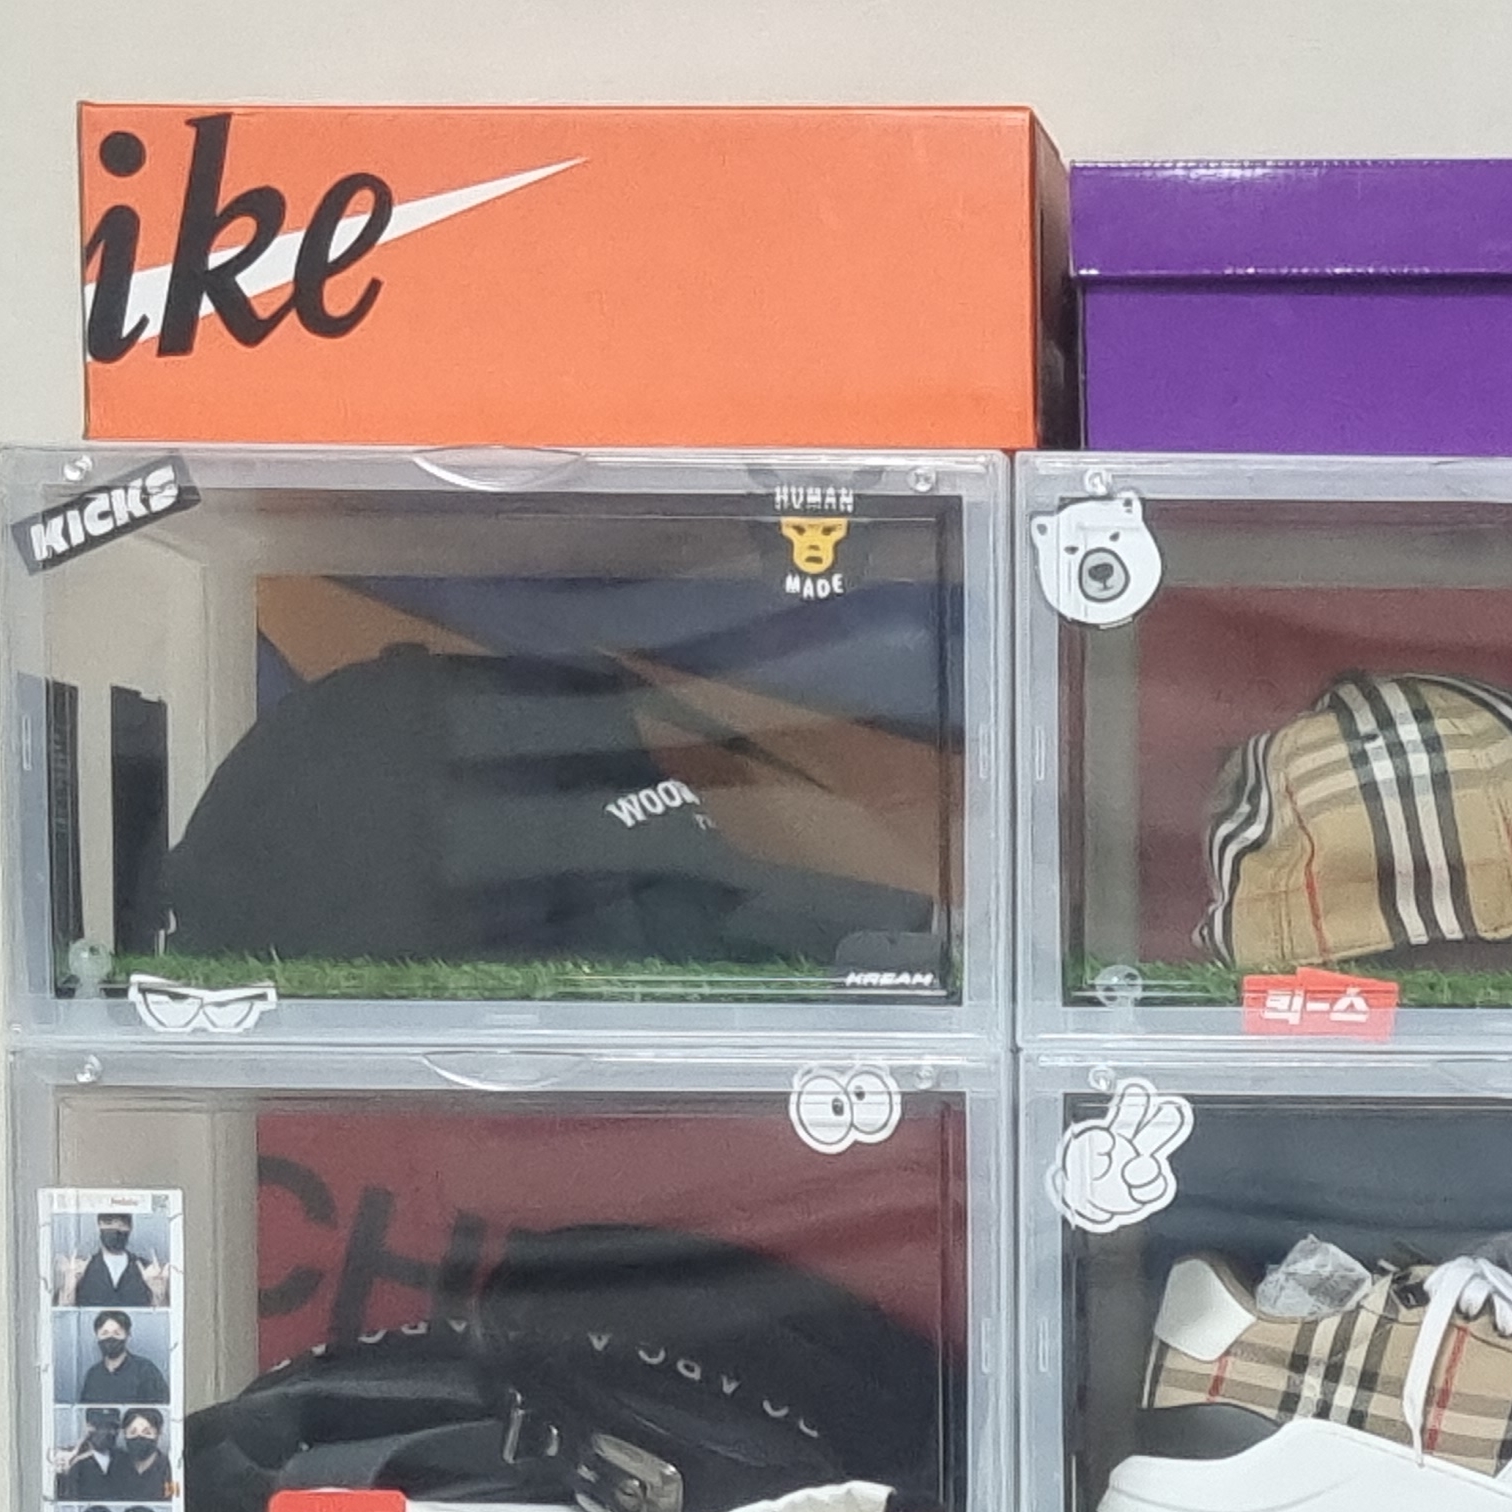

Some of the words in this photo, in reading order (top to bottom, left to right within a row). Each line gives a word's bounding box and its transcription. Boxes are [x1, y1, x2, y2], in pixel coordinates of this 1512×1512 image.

[774, 485, 854, 512] HUMAN
[30, 464, 179, 561] KICKS
[785, 573, 845, 599] MADE
[845, 971, 934, 987] KREAM
